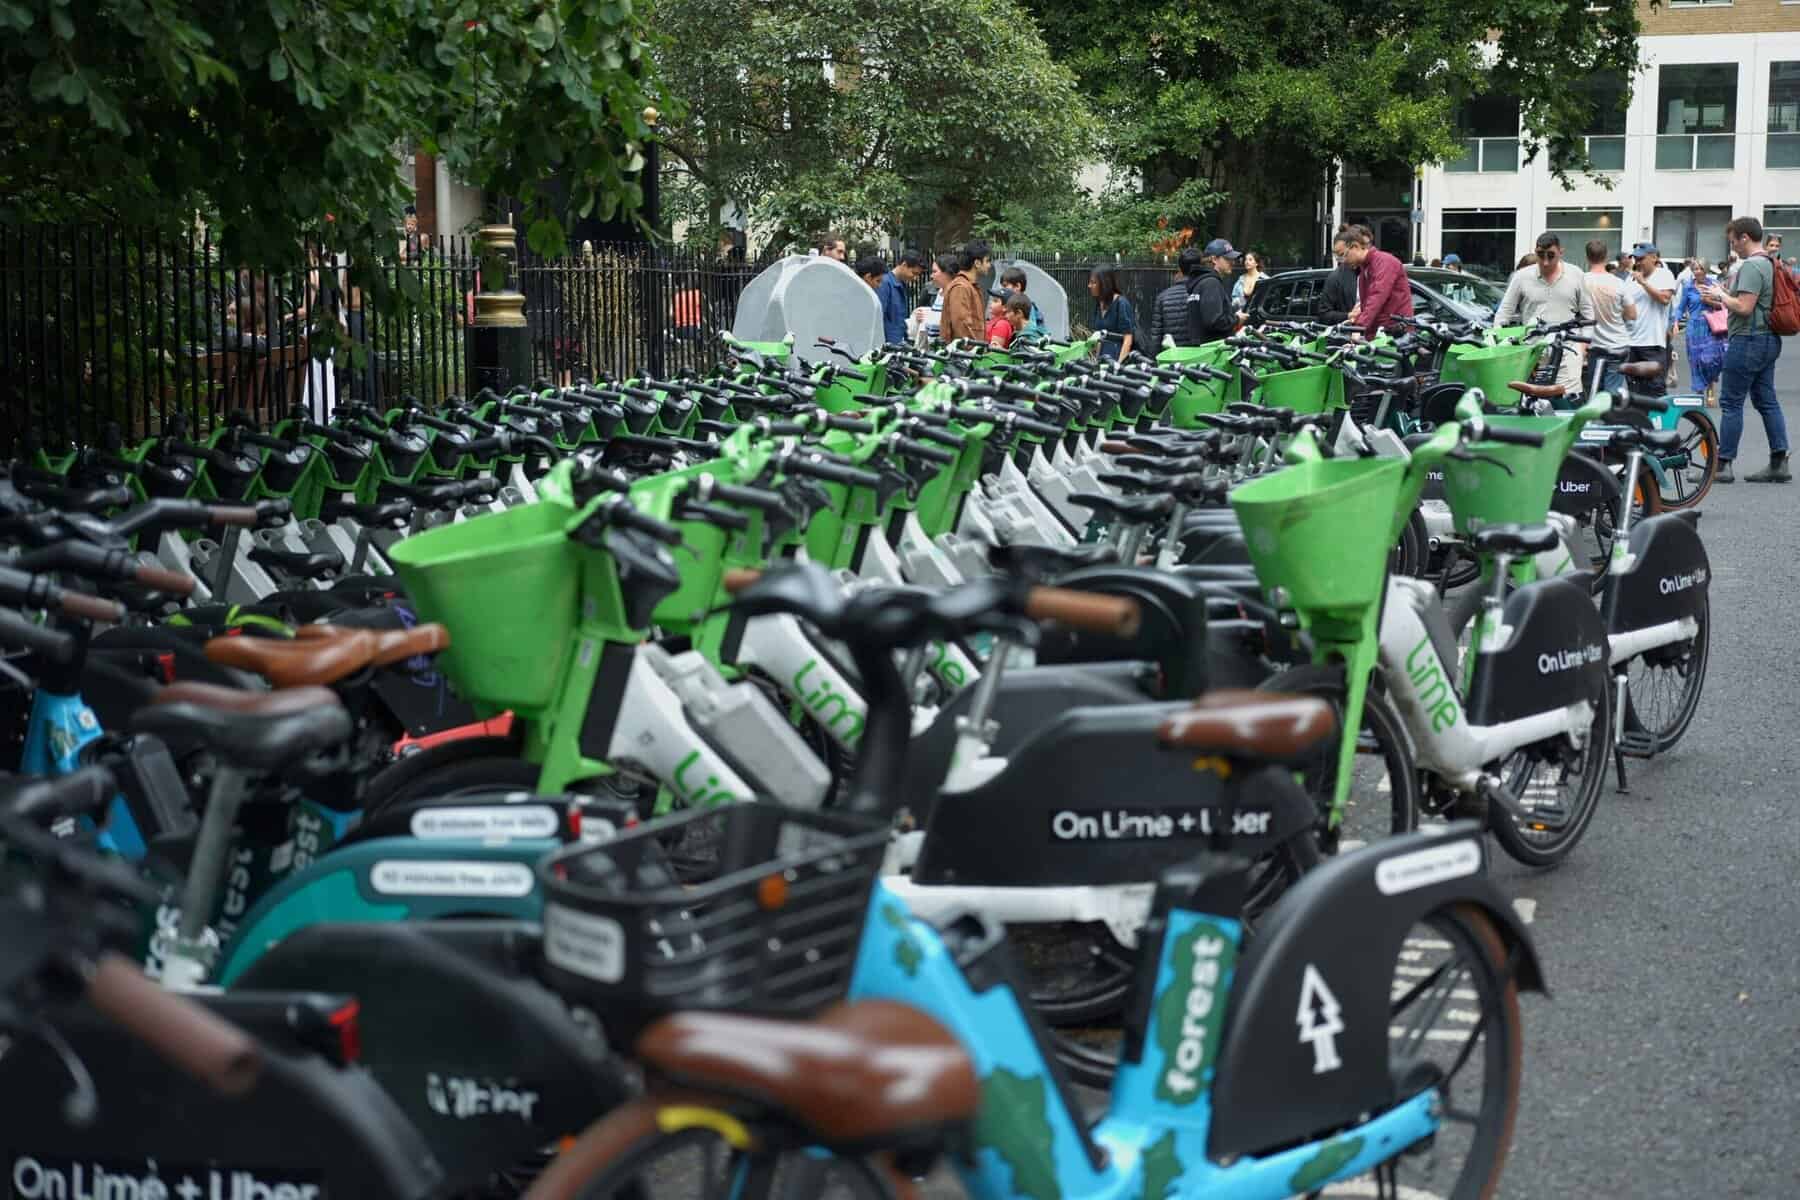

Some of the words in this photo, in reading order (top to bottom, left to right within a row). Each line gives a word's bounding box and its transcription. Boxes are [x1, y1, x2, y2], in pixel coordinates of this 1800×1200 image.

[1560, 480, 1591, 493] Uber
[1660, 577, 1676, 595] On
[1538, 653, 1559, 675] On
[793, 659, 865, 742] Lim
[1406, 634, 1458, 735] Lime
[1052, 810, 1099, 840] On
[1102, 809, 1173, 839] Lime
[1166, 934, 1225, 1096] forest
[13, 1156, 66, 1200] On
[72, 1160, 168, 1200] Lime
